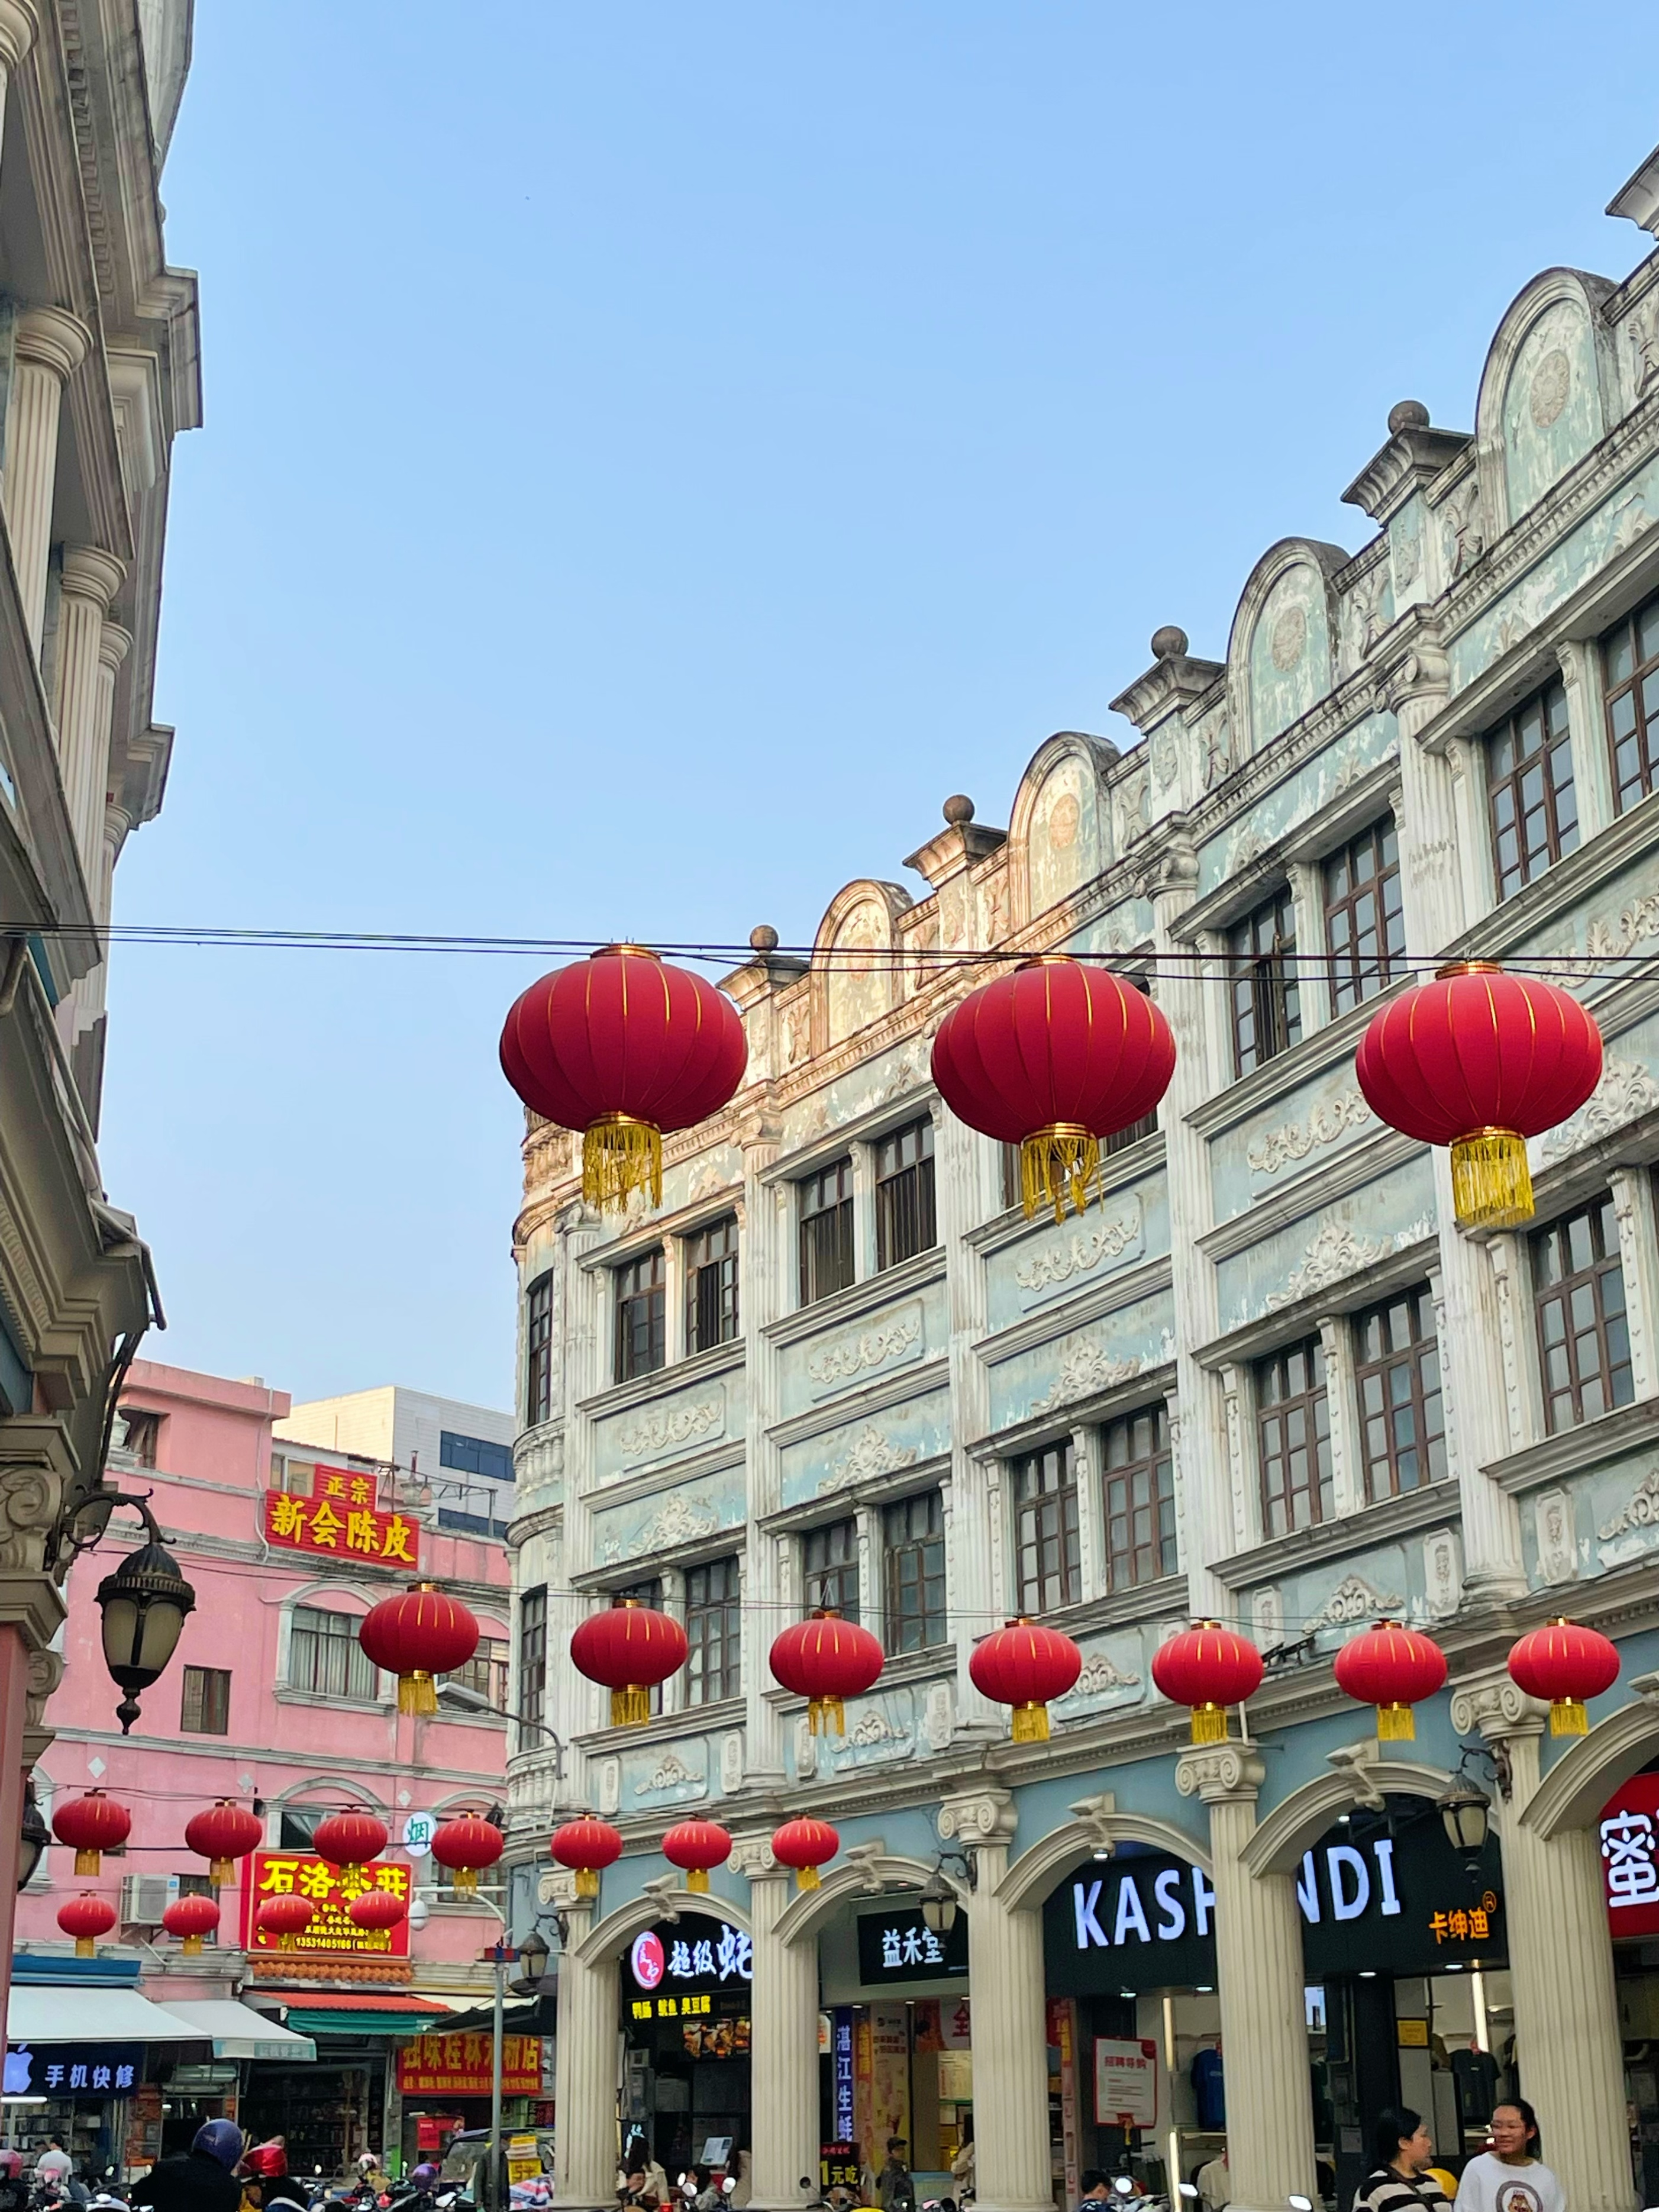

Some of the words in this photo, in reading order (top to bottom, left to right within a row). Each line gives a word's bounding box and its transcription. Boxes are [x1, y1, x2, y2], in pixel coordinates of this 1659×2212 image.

[326, 1476, 370, 1504] 正宗
[270, 1494, 416, 1562] 新会陈皮
[407, 1818, 429, 1849] 烟
[1600, 1810, 1659, 1908] 蜜
[1428, 1906, 1490, 1945] 卡绅迪
[882, 1926, 944, 1968] 益禾堂
[681, 1995, 711, 2015] 臭豆腐
[45, 2064, 134, 2089] 手机快修
[836, 2024, 853, 2142] 湛江生蚝
